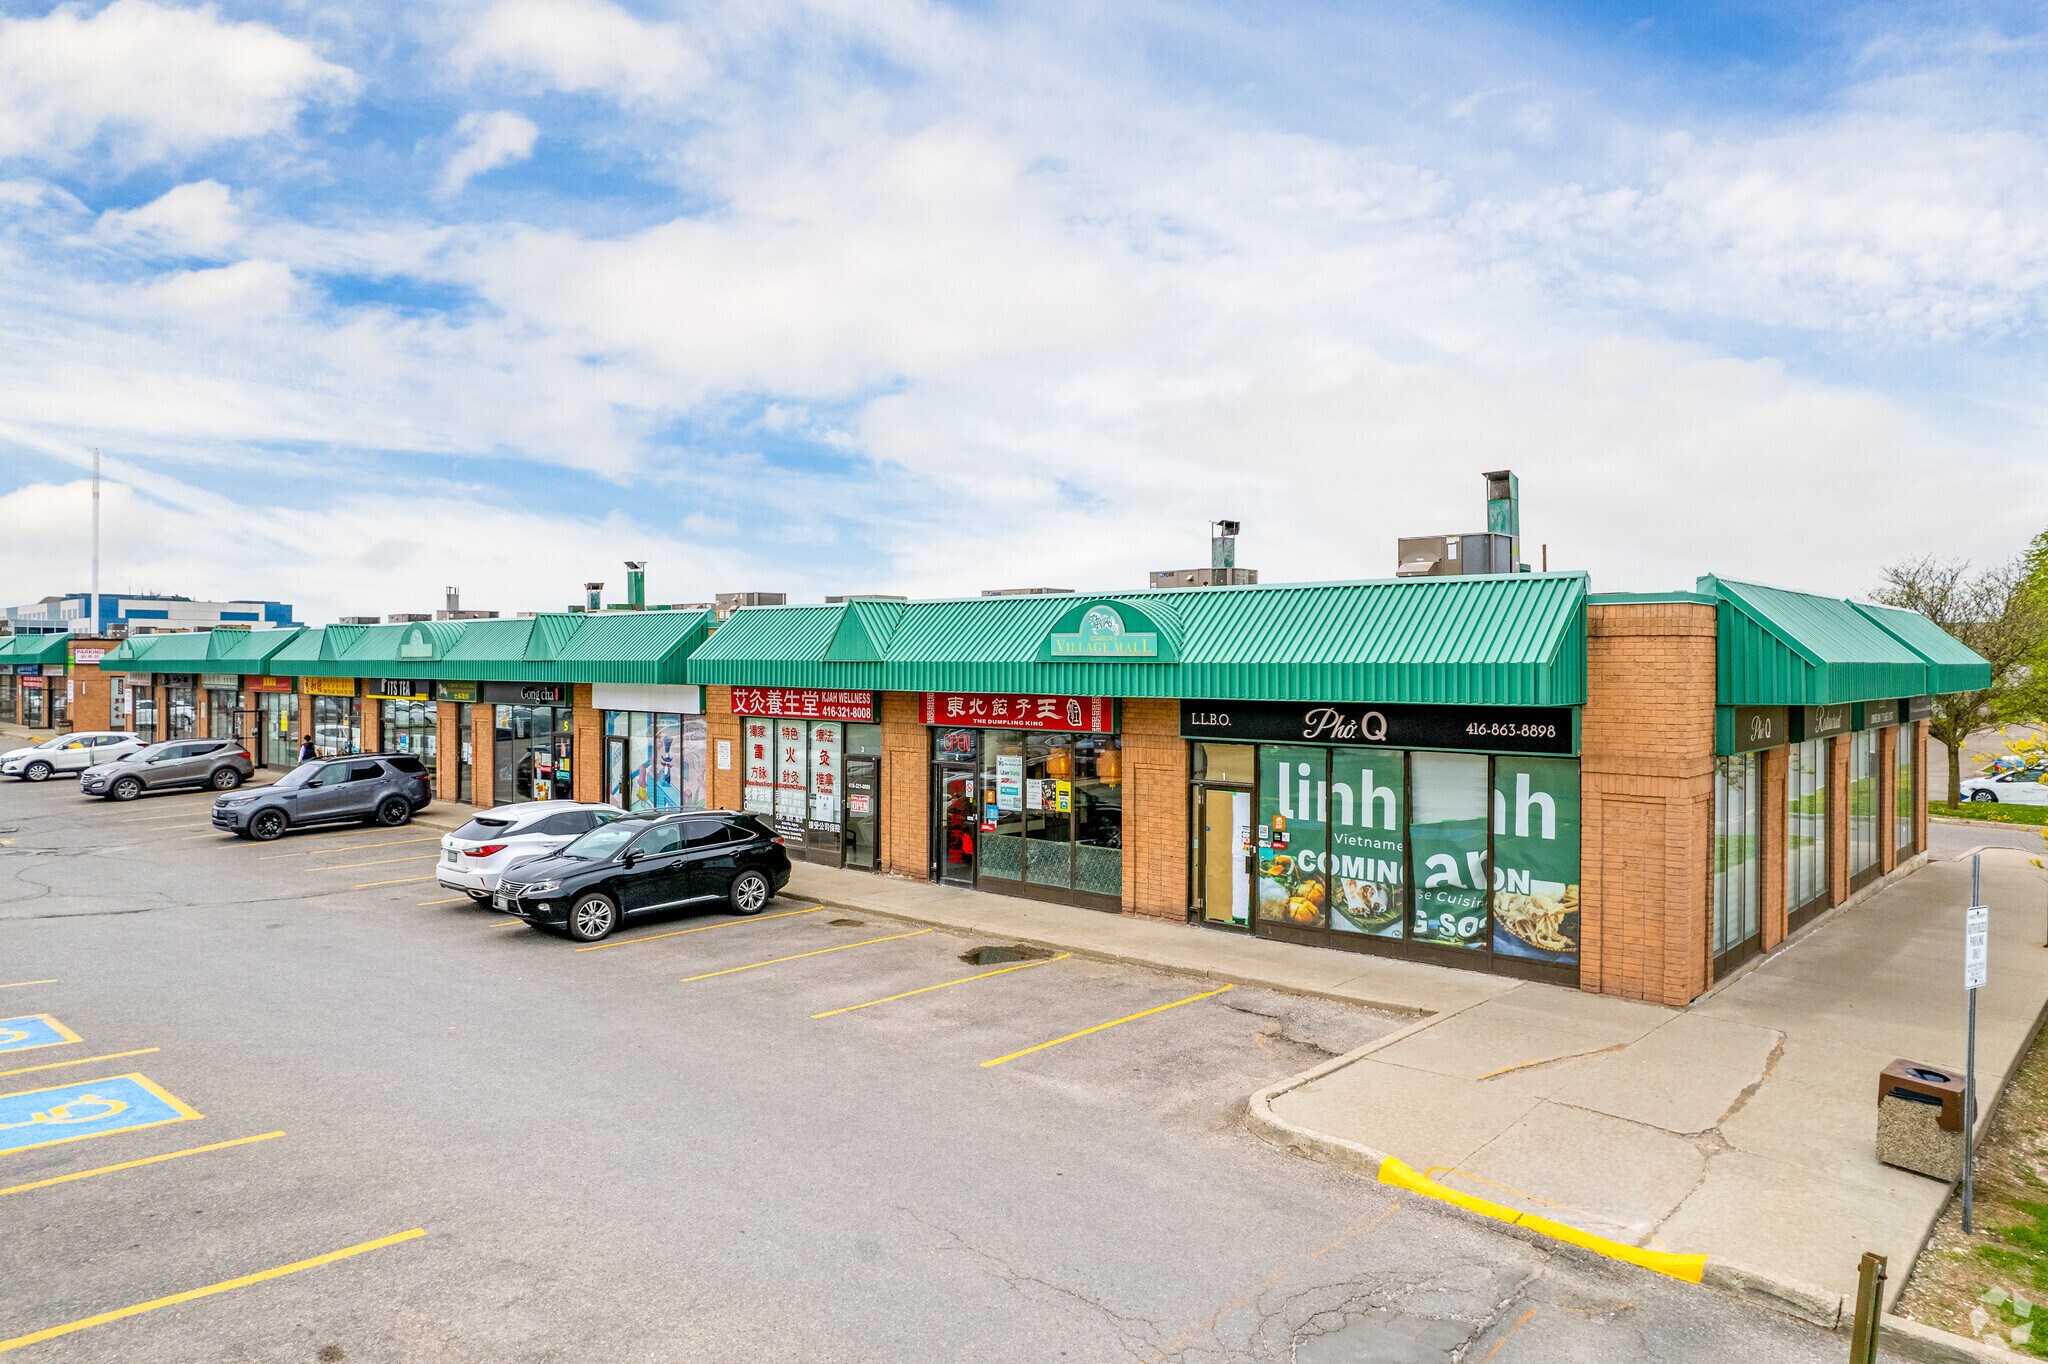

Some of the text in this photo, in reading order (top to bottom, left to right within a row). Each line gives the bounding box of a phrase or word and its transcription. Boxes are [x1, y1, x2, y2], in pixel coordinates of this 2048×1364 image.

[1056, 639, 1152, 654] VILLAGE MALL
[387, 680, 411, 697] ITS TEA
[520, 687, 554, 704] Gong cha
[732, 688, 820, 717] 艾灸養生堂
[821, 692, 871, 704] KJAH WELLNESS
[822, 706, 871, 719] 416-321-8008
[946, 696, 1063, 719] 東北餃子王
[563, 721, 569, 732] 5
[782, 727, 798, 740] 特色
[1361, 711, 1388, 742] Q
[1465, 722, 1556, 738] 416-863-8898
[943, 733, 971, 752] OPEN
[753, 744, 830, 766] 雷 火 灸
[955, 753, 960, 761] 2
[782, 769, 799, 784] 針灸
[1279, 762, 1397, 831] linh
[852, 801, 868, 811] OPEN
[1298, 849, 1403, 885] COMIN
